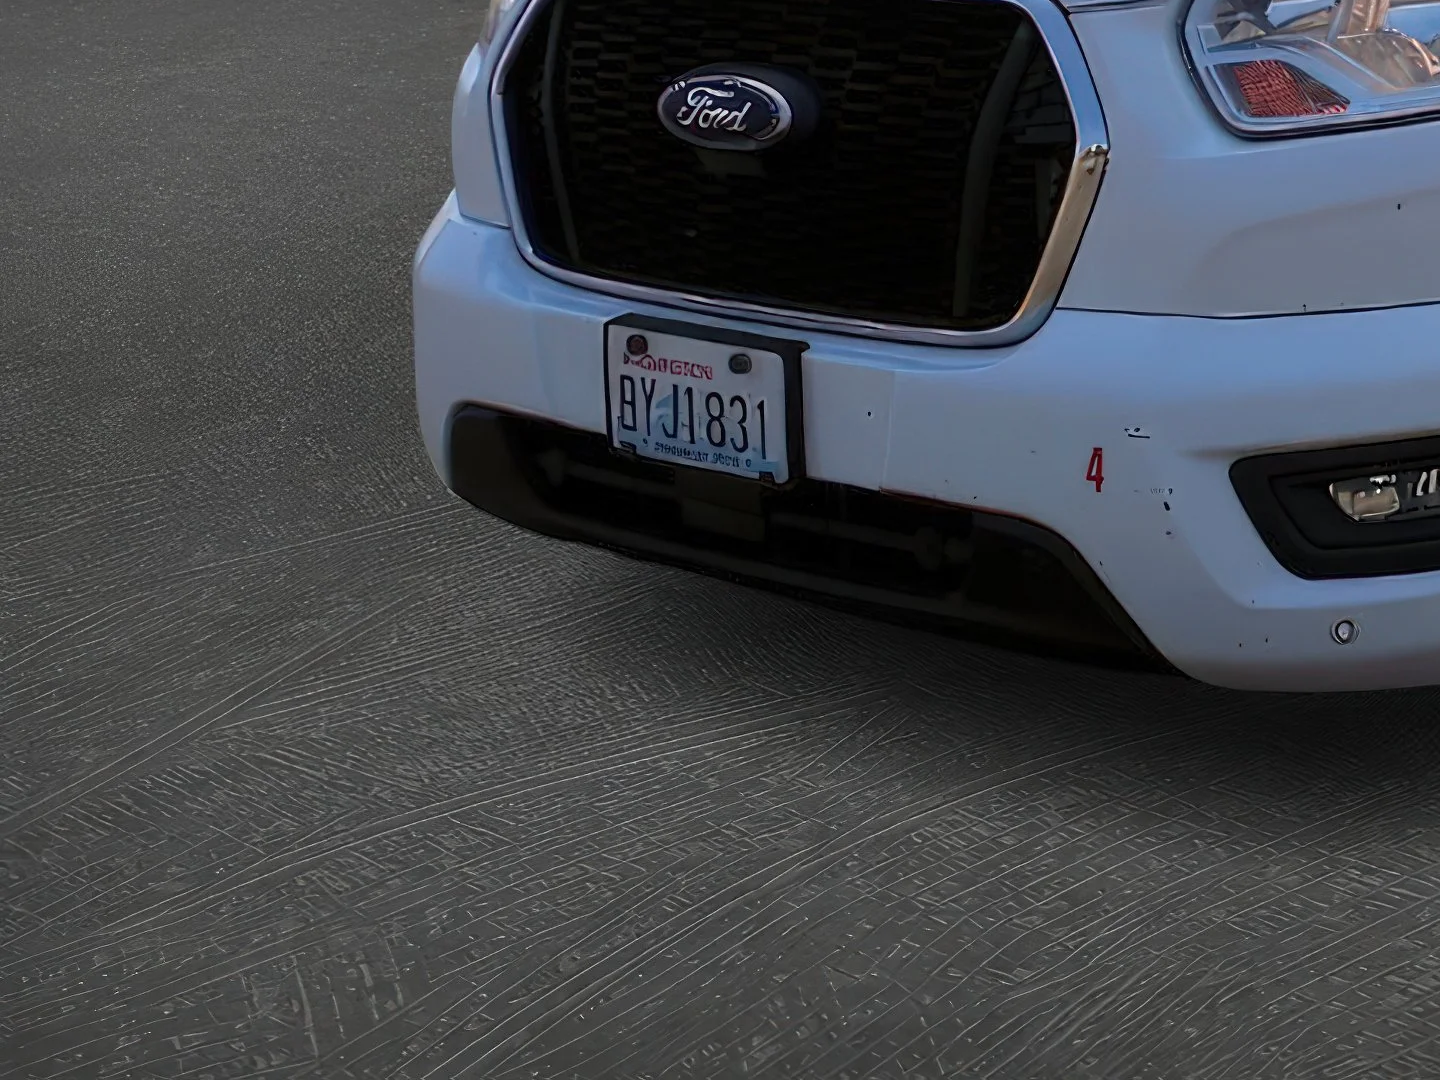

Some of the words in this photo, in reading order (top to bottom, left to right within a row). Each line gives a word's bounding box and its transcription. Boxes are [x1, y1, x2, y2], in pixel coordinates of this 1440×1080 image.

[676, 86, 752, 132] Ford
[619, 374, 767, 460] BYJ1831
[1086, 447, 1104, 493] 4
